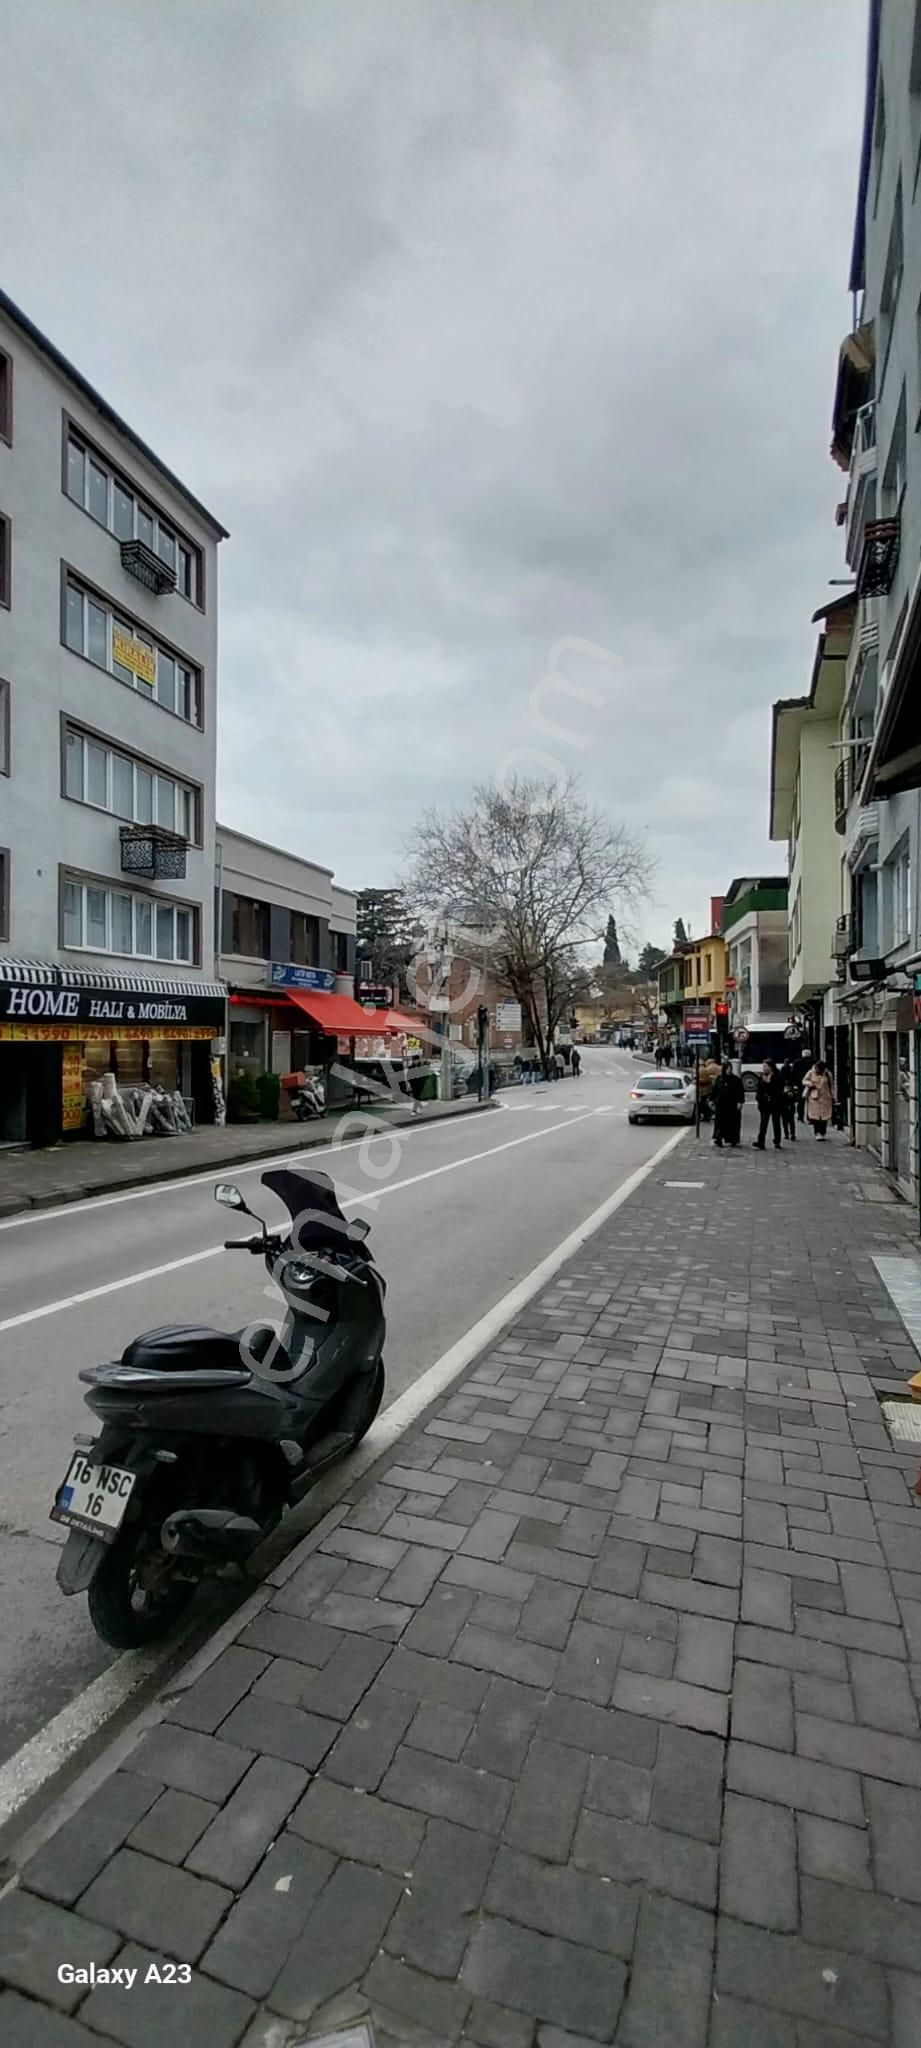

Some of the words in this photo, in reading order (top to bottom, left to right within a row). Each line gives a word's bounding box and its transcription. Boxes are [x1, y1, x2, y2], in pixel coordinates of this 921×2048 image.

[6, 988, 80, 1016] HOME
[89, 1000, 124, 1018] HALI
[127, 1006, 136, 1019] &
[138, 1001, 187, 1020] MOBİLYA
[74, 1460, 94, 1484] 16
[96, 1466, 132, 1498] NSC
[84, 1492, 105, 1516] 16
